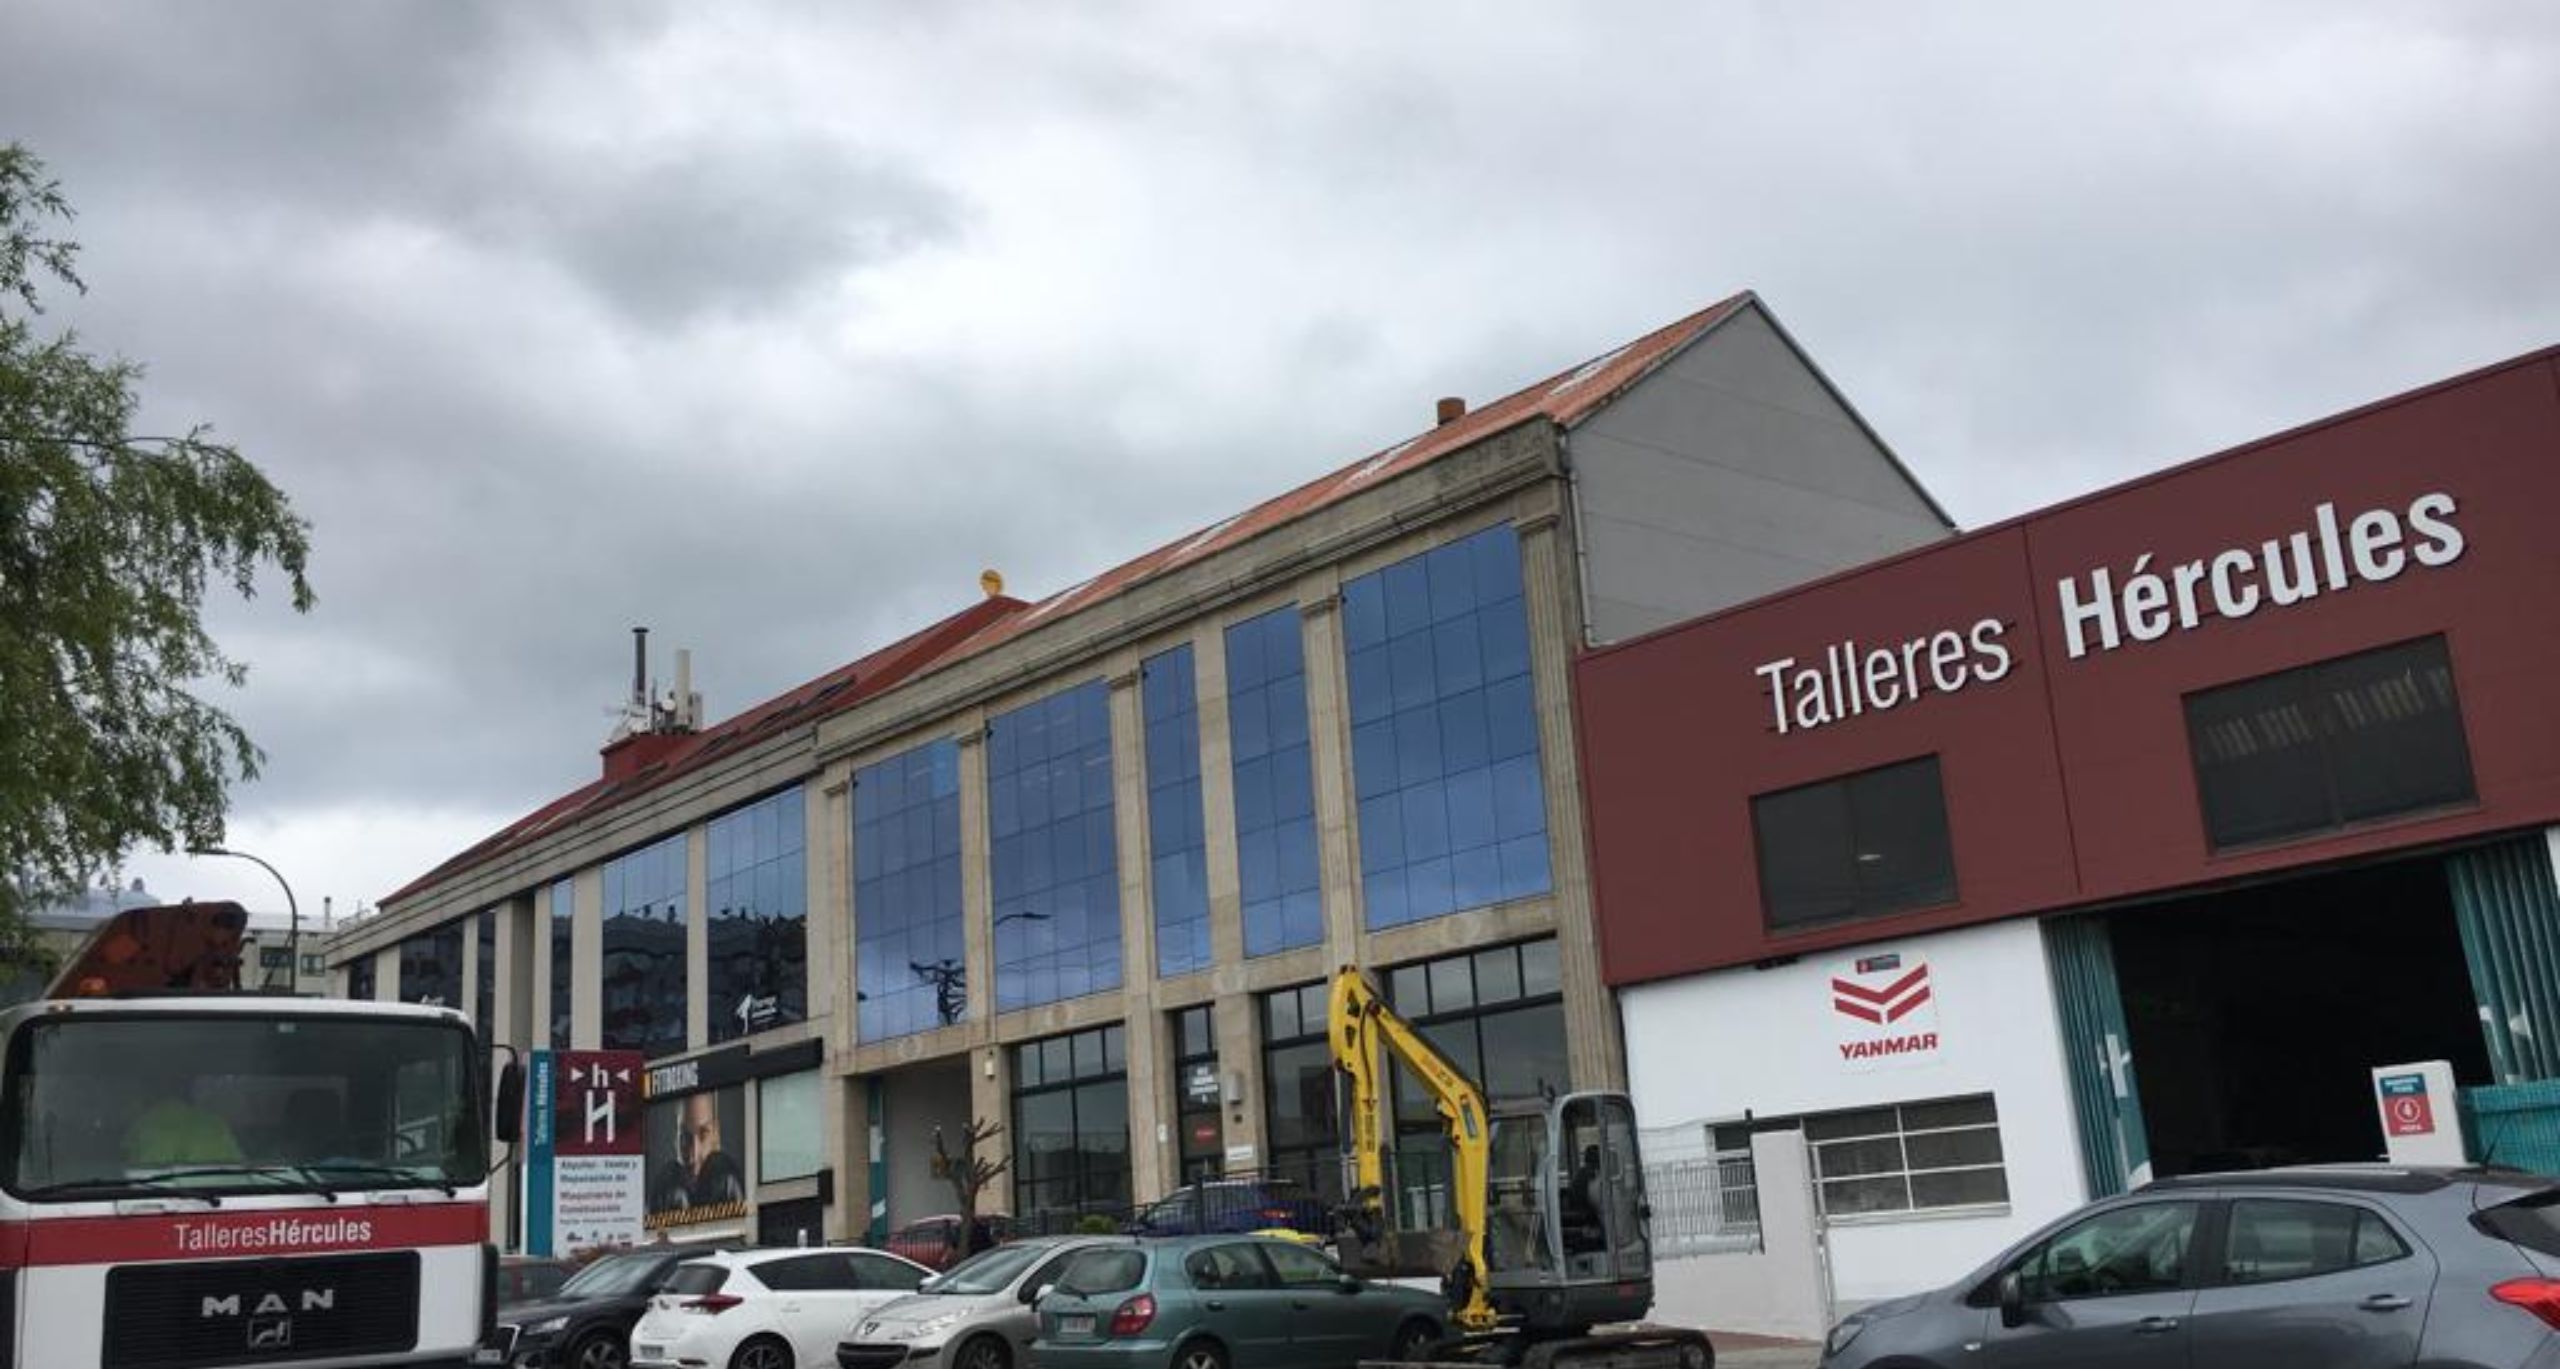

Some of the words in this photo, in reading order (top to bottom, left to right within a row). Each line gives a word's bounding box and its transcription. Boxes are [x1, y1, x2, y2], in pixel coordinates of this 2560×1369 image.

[1755, 617, 2011, 735] Talleres
[2057, 491, 2466, 659] Hércules
[1839, 1032, 1939, 1060] YANMAR
[202, 1288, 334, 1318] MAN
